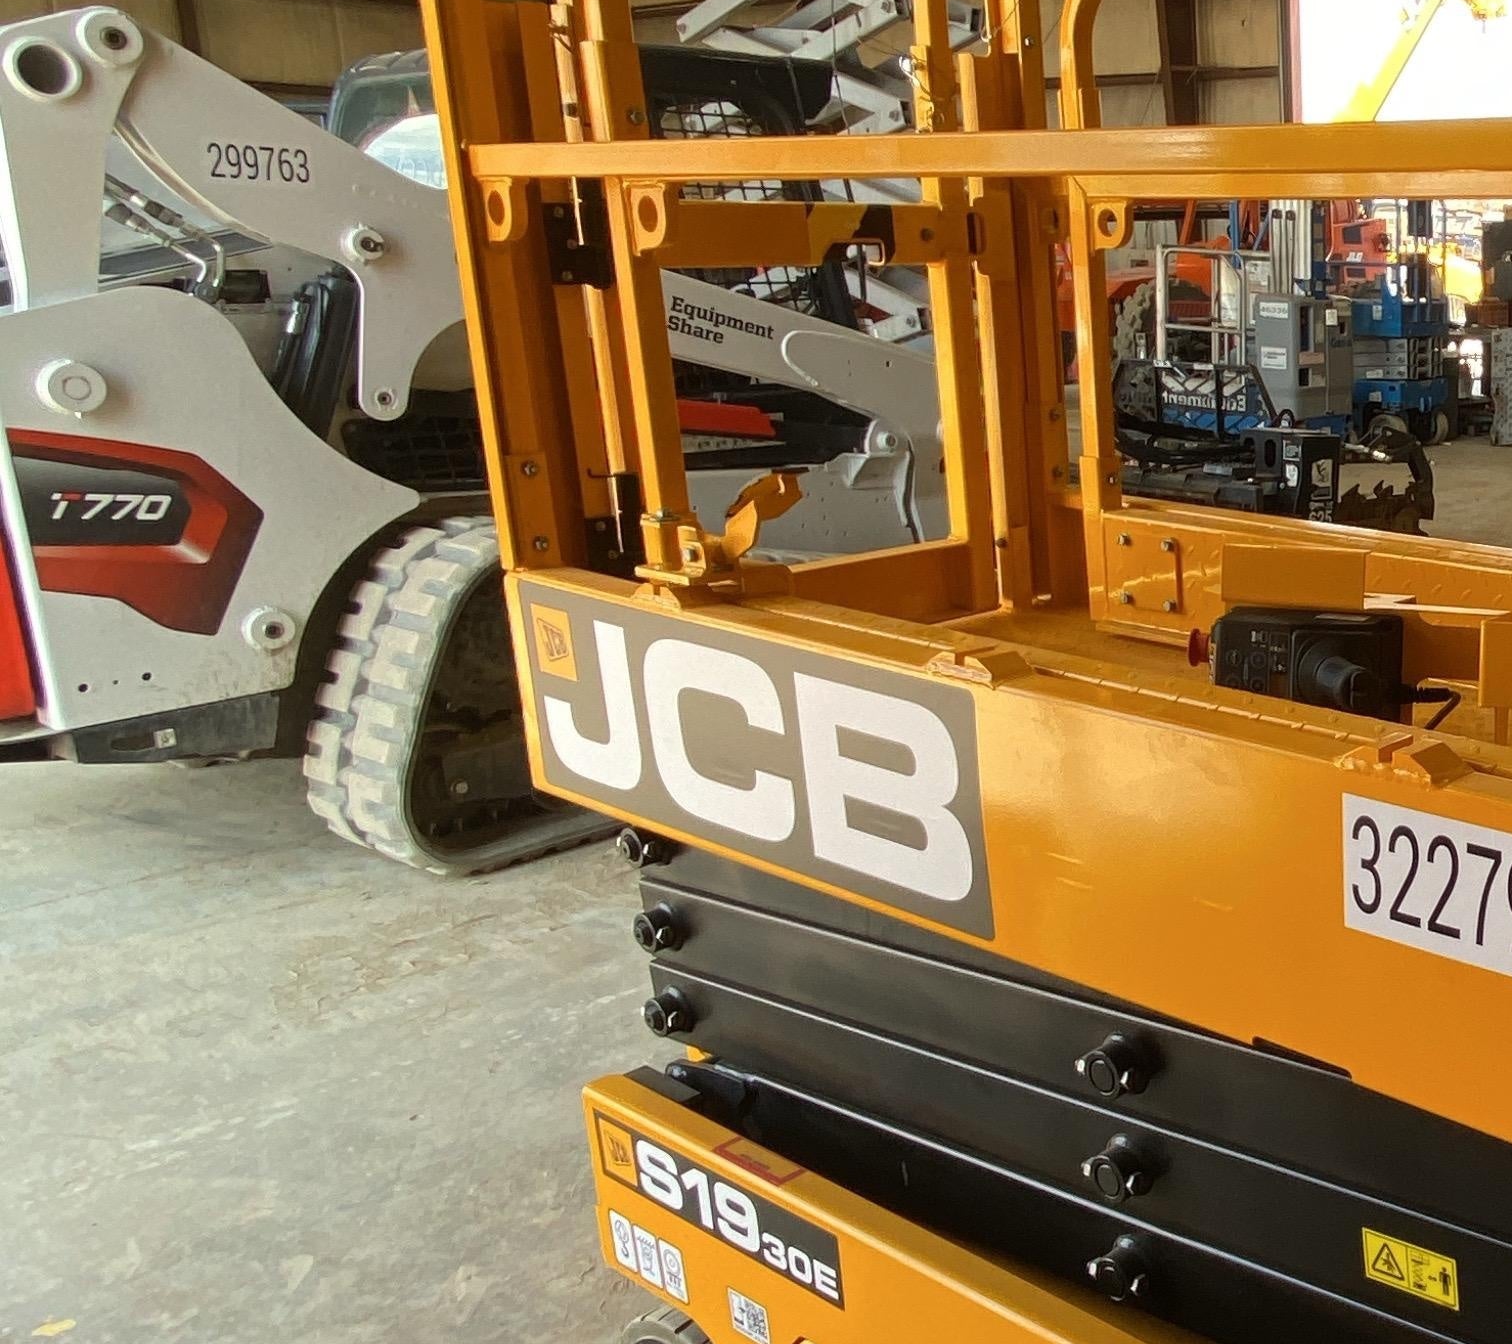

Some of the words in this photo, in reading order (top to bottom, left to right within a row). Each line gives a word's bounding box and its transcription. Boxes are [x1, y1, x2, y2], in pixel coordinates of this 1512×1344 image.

[207, 142, 310, 183] 299763
[667, 315, 725, 344] Share
[670, 295, 775, 340] Equipment
[543, 619, 974, 902] JCB
